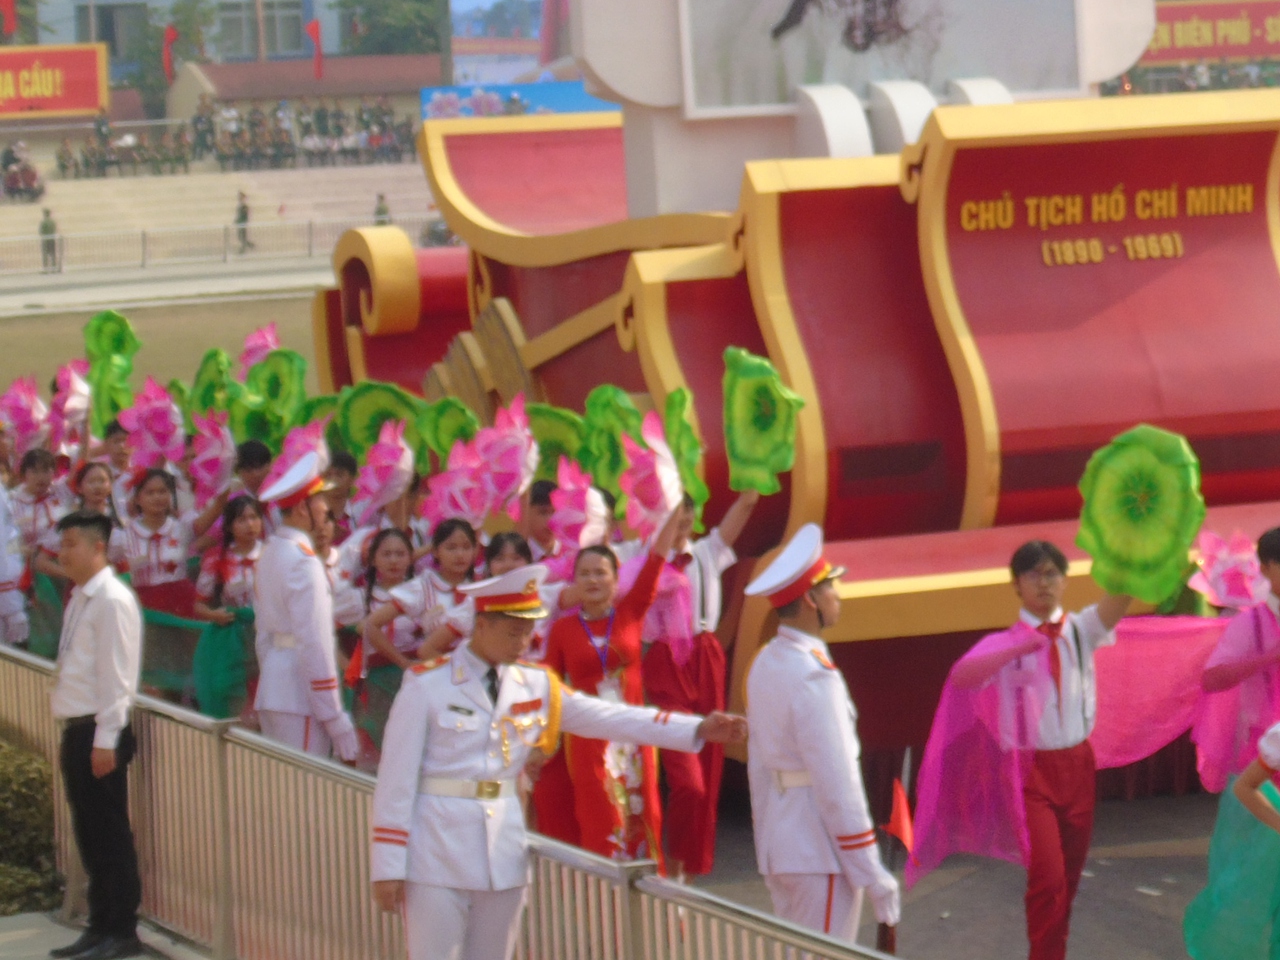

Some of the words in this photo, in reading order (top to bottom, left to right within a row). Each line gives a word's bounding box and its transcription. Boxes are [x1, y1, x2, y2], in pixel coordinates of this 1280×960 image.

[1173, 15, 1214, 49] BIÊN
[960, 191, 1014, 231] CHỦ
[1024, 194, 1084, 231] TỊCH
[1135, 182, 1178, 220] CHÍ
[1186, 184, 1255, 217] MINH
